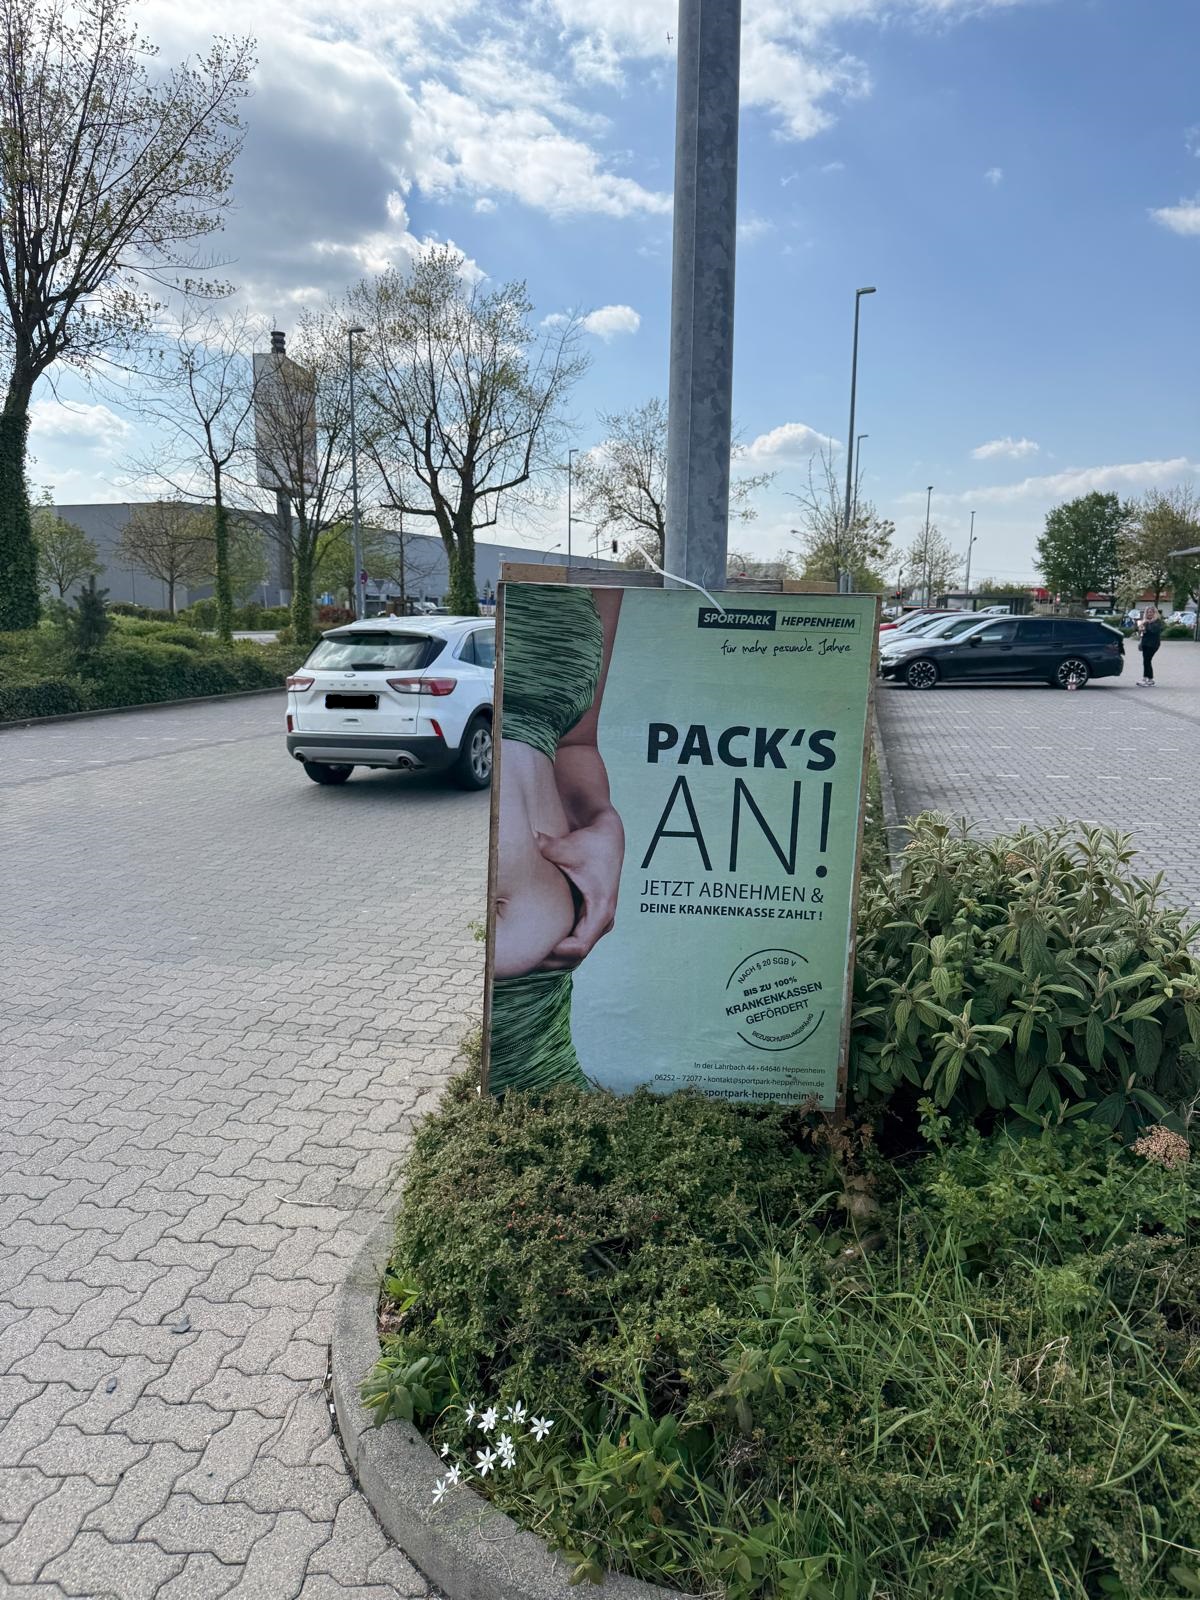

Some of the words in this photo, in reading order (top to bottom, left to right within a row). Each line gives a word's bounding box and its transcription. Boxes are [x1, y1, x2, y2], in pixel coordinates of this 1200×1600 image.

[703, 612, 772, 625] SPORTPARK
[781, 616, 856, 628] HEPPENHEIM
[721, 639, 737, 656] für
[742, 640, 768, 654] mehr
[772, 638, 813, 657] gesunde
[818, 638, 852, 655] Jahre
[640, 775, 833, 878] AN!
[640, 880, 695, 897] JETZT
[699, 882, 806, 902] ABNEHMEN
[811, 887, 824, 904] &
[640, 903, 676, 914] DEINE
[679, 904, 775, 919] KRANKENKASSE
[738, 966, 756, 984] NACH
[763, 959, 771, 967] 20
[773, 957, 790, 965] SGB
[743, 987, 758, 997] BIS
[759, 983, 772, 992] ZU
[774, 976, 798, 988] 100%
[725, 981, 823, 1016] KRANKENKASSEN
[746, 999, 809, 1024] GEFÖRDERT
[702, 1062, 713, 1070] der
[782, 1066, 826, 1074] Heppenheim
